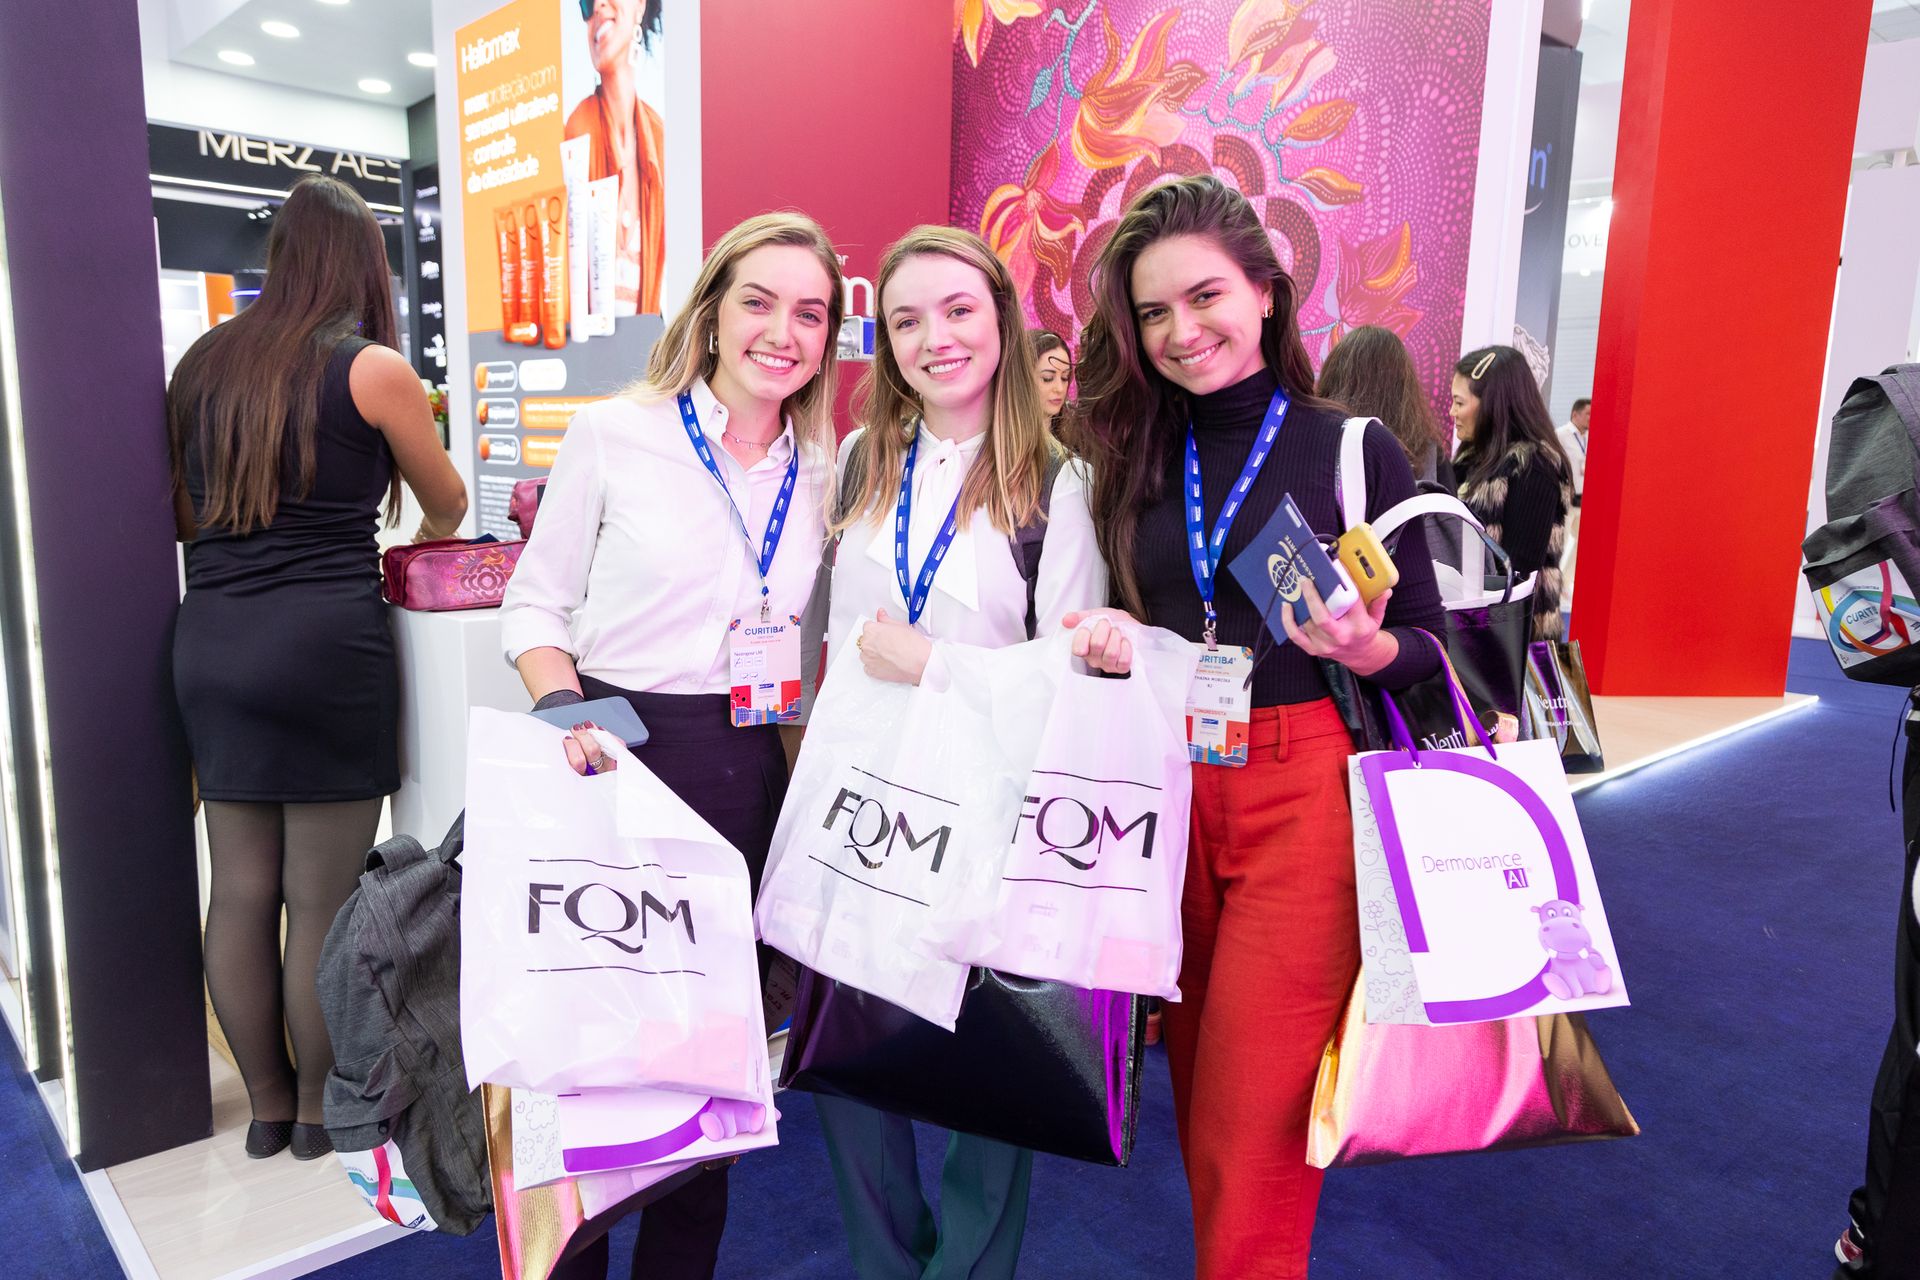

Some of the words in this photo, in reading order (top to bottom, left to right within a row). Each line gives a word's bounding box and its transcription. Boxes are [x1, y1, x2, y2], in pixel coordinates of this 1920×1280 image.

[199, 130, 322, 173] MERZ
[744, 625, 785, 636] CURITIBA
[1199, 655, 1236, 665] URITIBA
[822, 786, 952, 874] FQM
[1011, 795, 1159, 871] FQM
[1422, 853, 1523, 873] Dermovance
[528, 882, 697, 954] FQM
